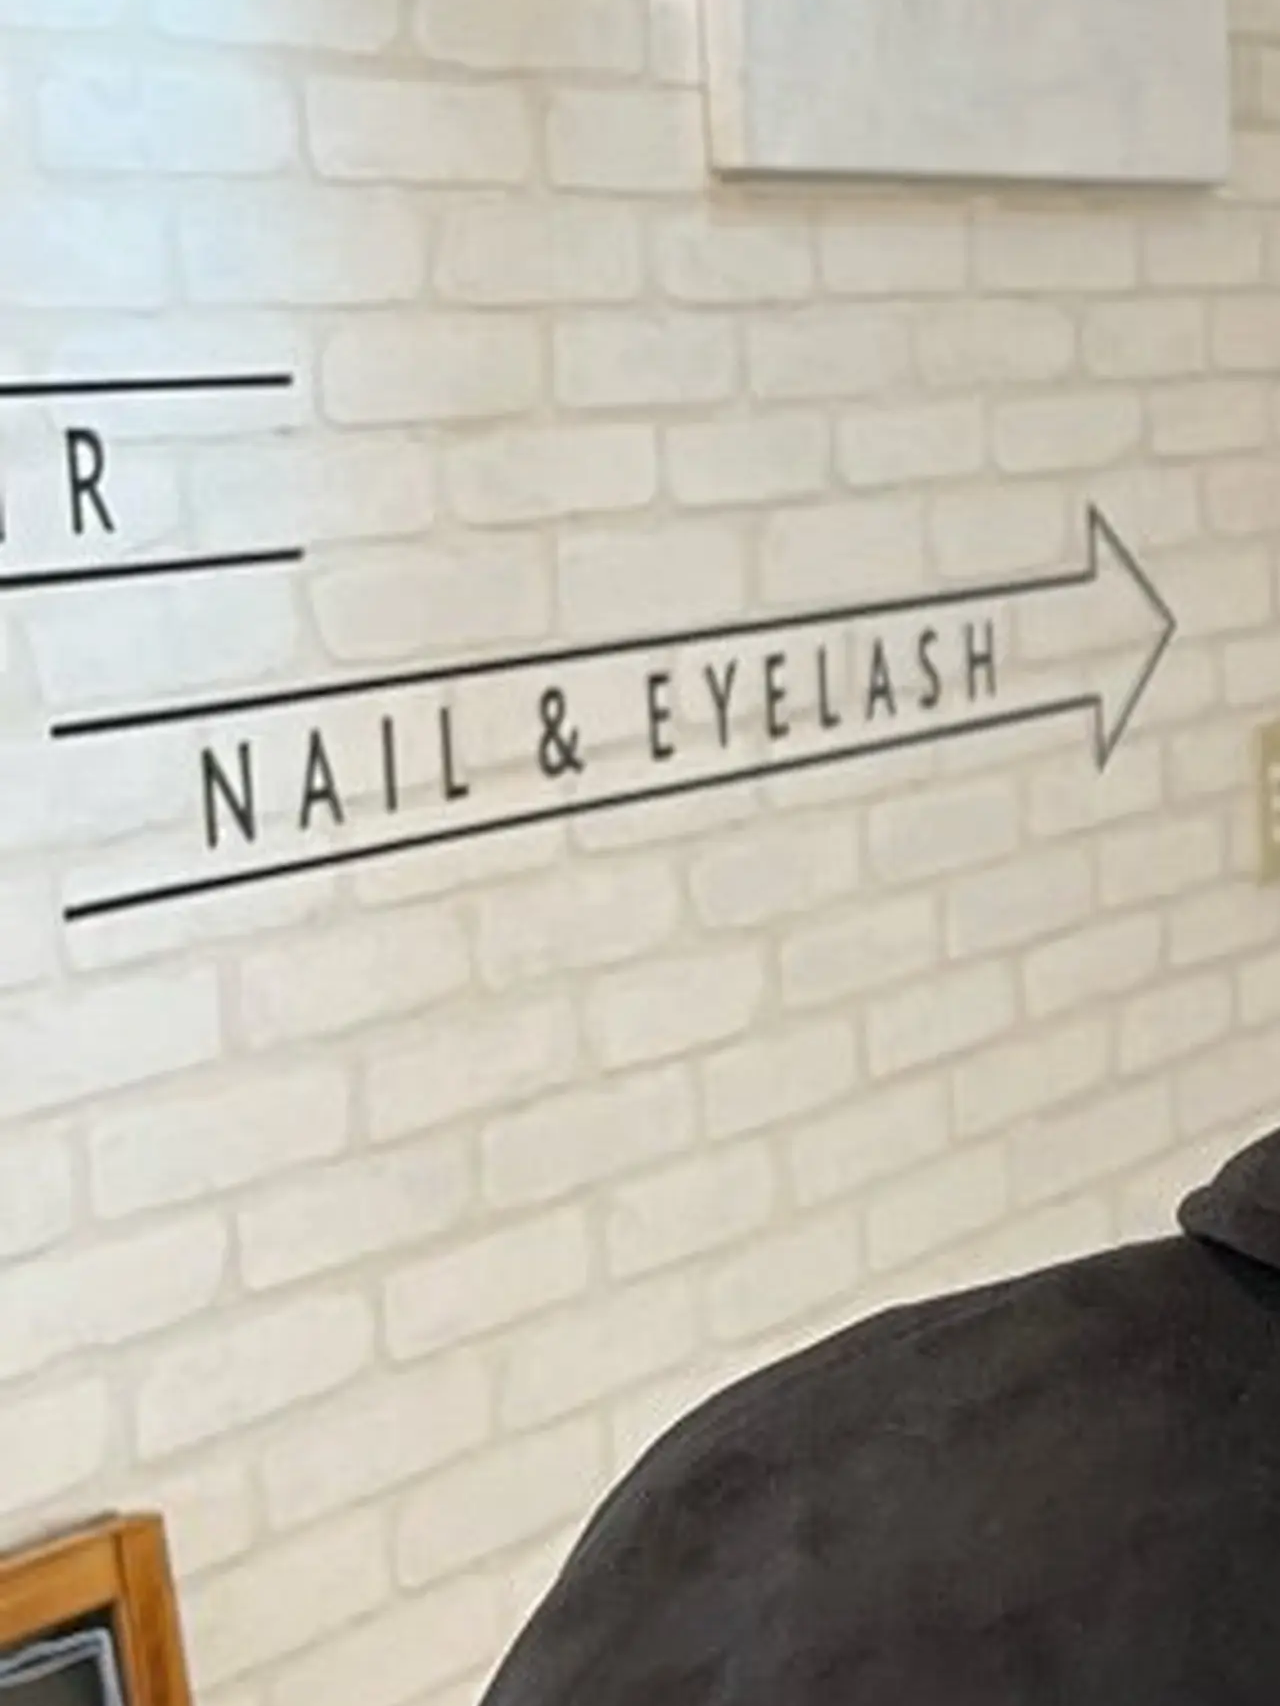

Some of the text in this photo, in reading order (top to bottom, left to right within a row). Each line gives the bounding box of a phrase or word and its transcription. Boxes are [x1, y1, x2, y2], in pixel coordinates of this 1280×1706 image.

[0, 425, 116, 542] R
[201, 620, 997, 849] NAIL & EYELASH
